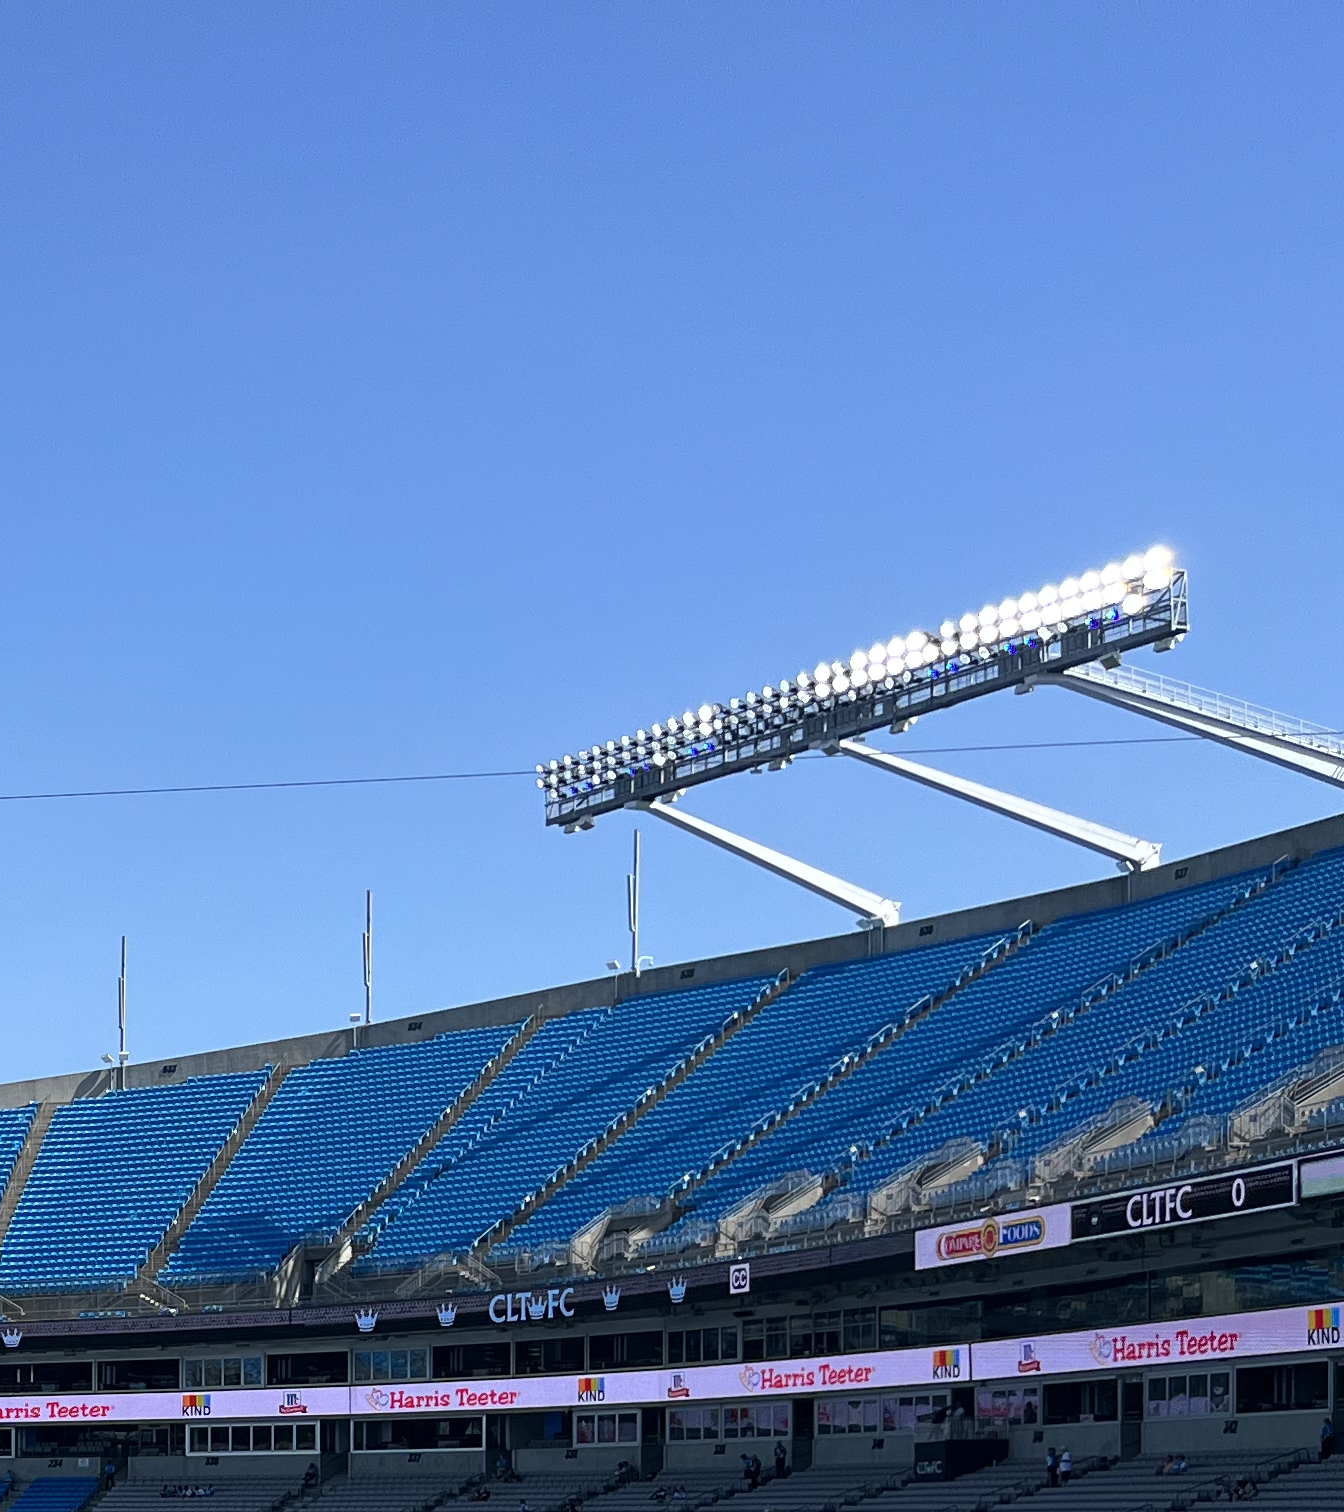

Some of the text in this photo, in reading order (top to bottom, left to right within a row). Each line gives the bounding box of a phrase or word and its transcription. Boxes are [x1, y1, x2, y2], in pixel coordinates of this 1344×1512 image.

[1126, 1178, 1246, 1228] CLTFC 0
[1112, 1329, 1239, 1362] Harris Teeter
[1307, 1326, 1341, 1346] KIND
[760, 1362, 875, 1391] Harris Teeter
[933, 1363, 961, 1380] KIND
[389, 1387, 518, 1409] Harris Teeter
[578, 1390, 605, 1402] KIND
[46, 1402, 110, 1418] Teeter
[182, 1405, 211, 1417] KIND
